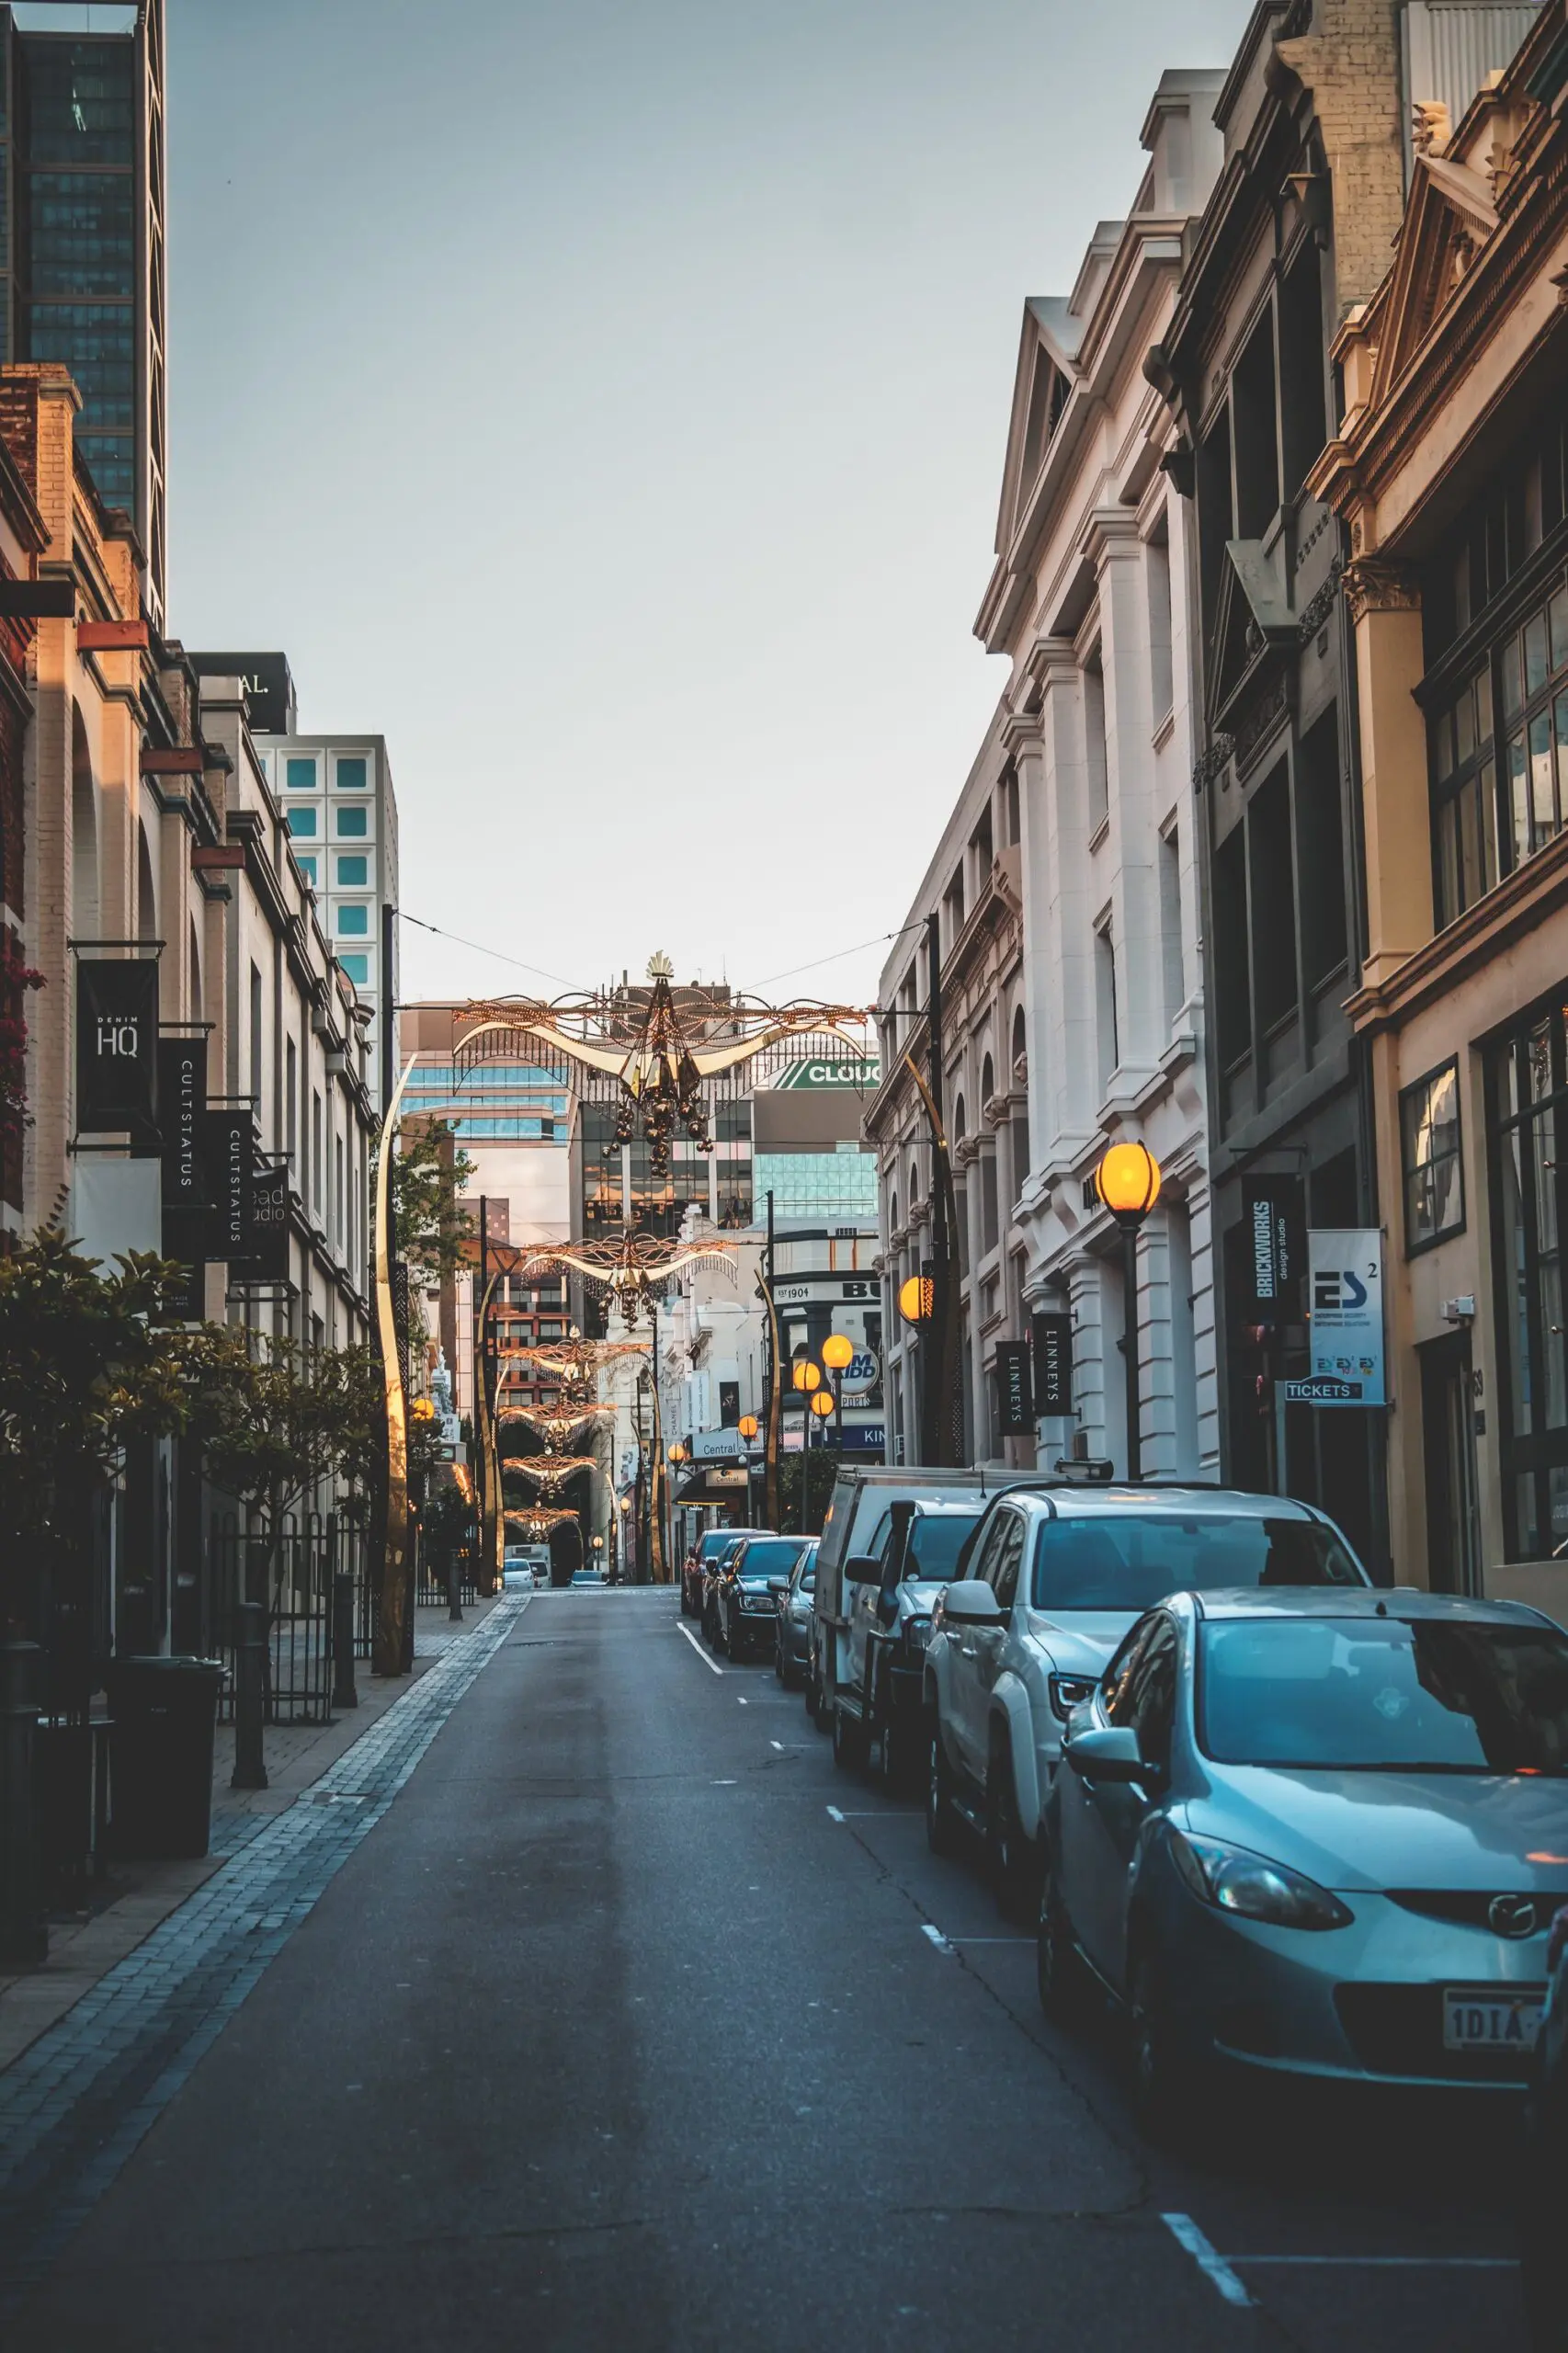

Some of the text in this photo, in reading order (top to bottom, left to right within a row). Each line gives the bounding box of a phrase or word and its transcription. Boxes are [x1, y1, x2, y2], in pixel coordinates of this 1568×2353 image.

[97, 1026, 138, 1058] HQ
[181, 1060, 193, 1187] CULTSTATUS
[230, 1130, 241, 1242] CULTSTATUS
[1253, 1200, 1273, 1298] BRICKWORKS
[1278, 1218, 1289, 1279] design studio
[1367, 1262, 1378, 1279] 2
[788, 1287, 809, 1298] 1904
[1047, 1330, 1058, 1400] LINNEYS
[842, 1396, 870, 1408] PORTS
[1009, 1357, 1021, 1421] LINNEYS
[1288, 1384, 1350, 1397] TICKETS
[703, 1442, 736, 1455] Central
